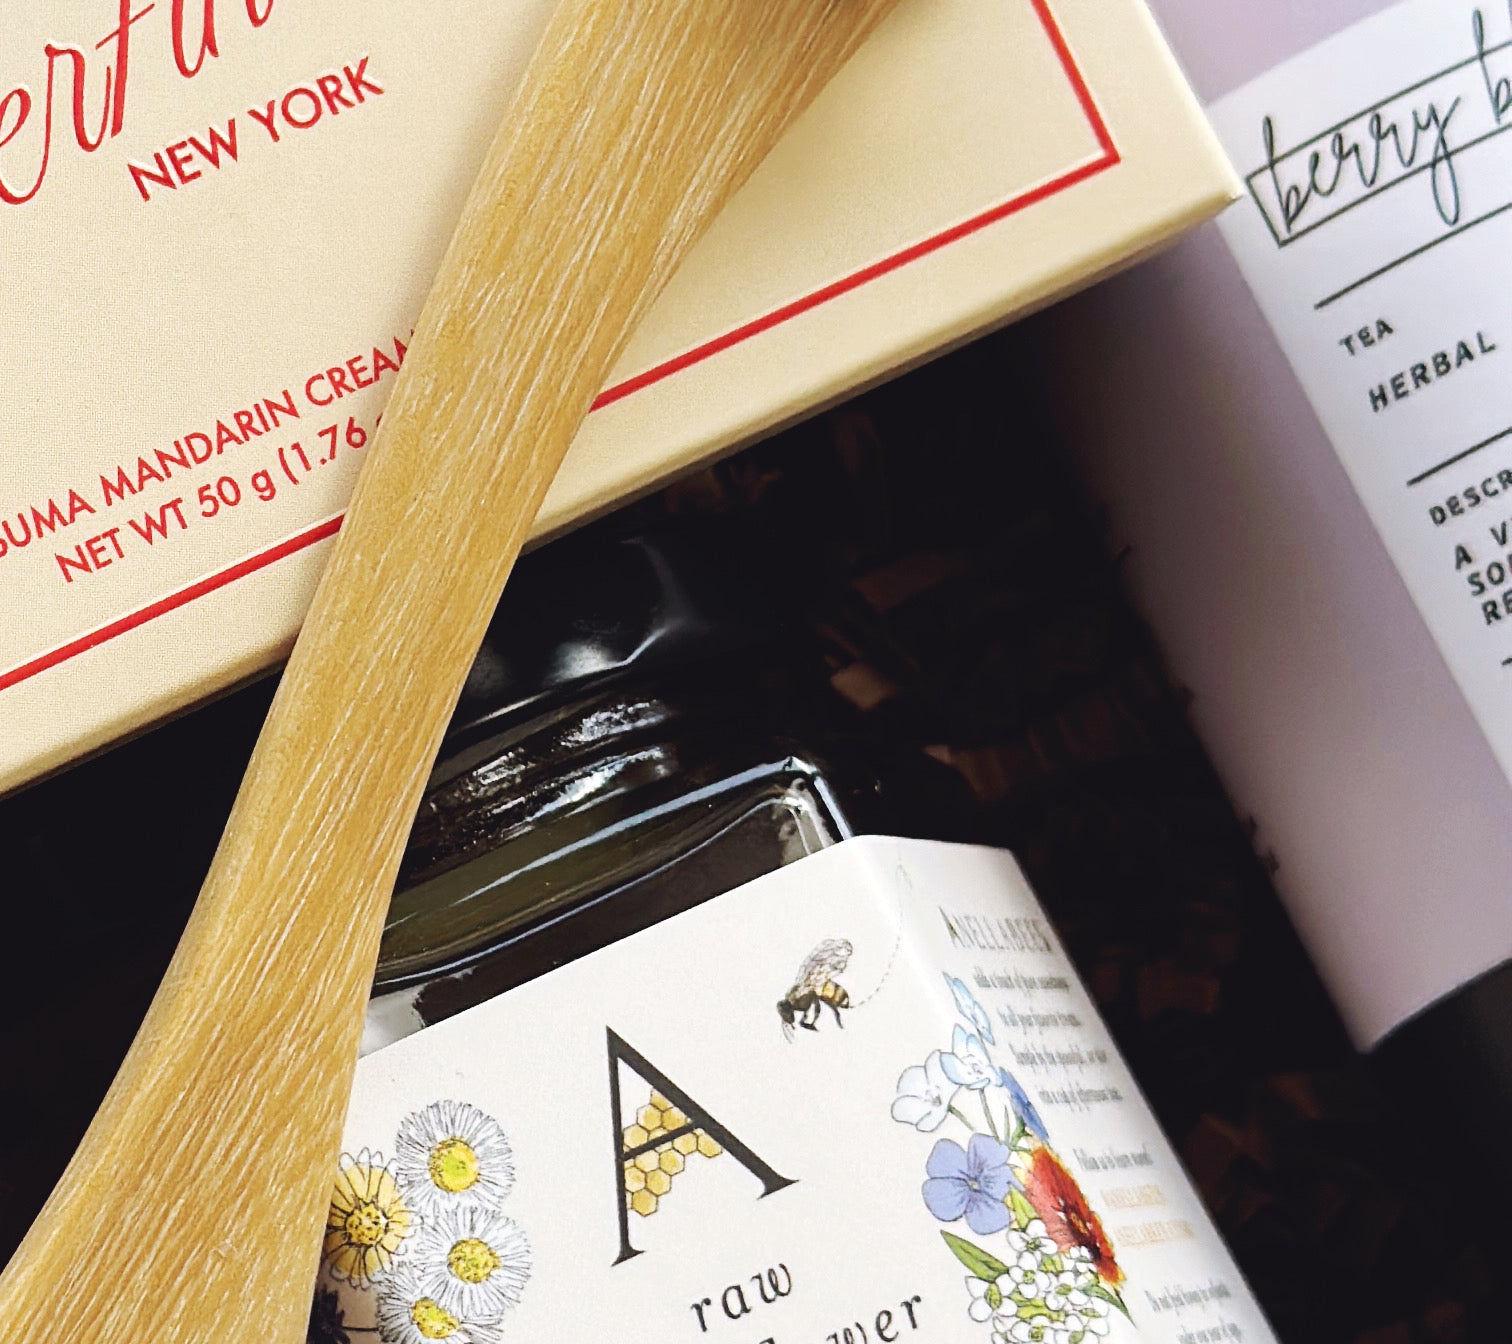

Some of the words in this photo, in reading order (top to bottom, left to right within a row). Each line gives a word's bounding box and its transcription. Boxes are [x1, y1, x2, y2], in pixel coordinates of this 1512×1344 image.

[127, 119, 239, 202] NEW
[248, 57, 385, 143] YORK
[1260, 96, 1462, 227] berry
[1339, 318, 1395, 357] TEA
[1368, 330, 1497, 413] HERBAL
[99, 389, 300, 507] MANDARIN
[54, 527, 126, 583] NET
[128, 497, 189, 546] WT
[197, 476, 242, 519] 50
[251, 469, 277, 503] g
[278, 416, 368, 487] (1.76
[1429, 469, 1512, 528] DESCR
[1454, 543, 1473, 571] A
[605, 1024, 801, 1268] A
[691, 1261, 795, 1335] raw
